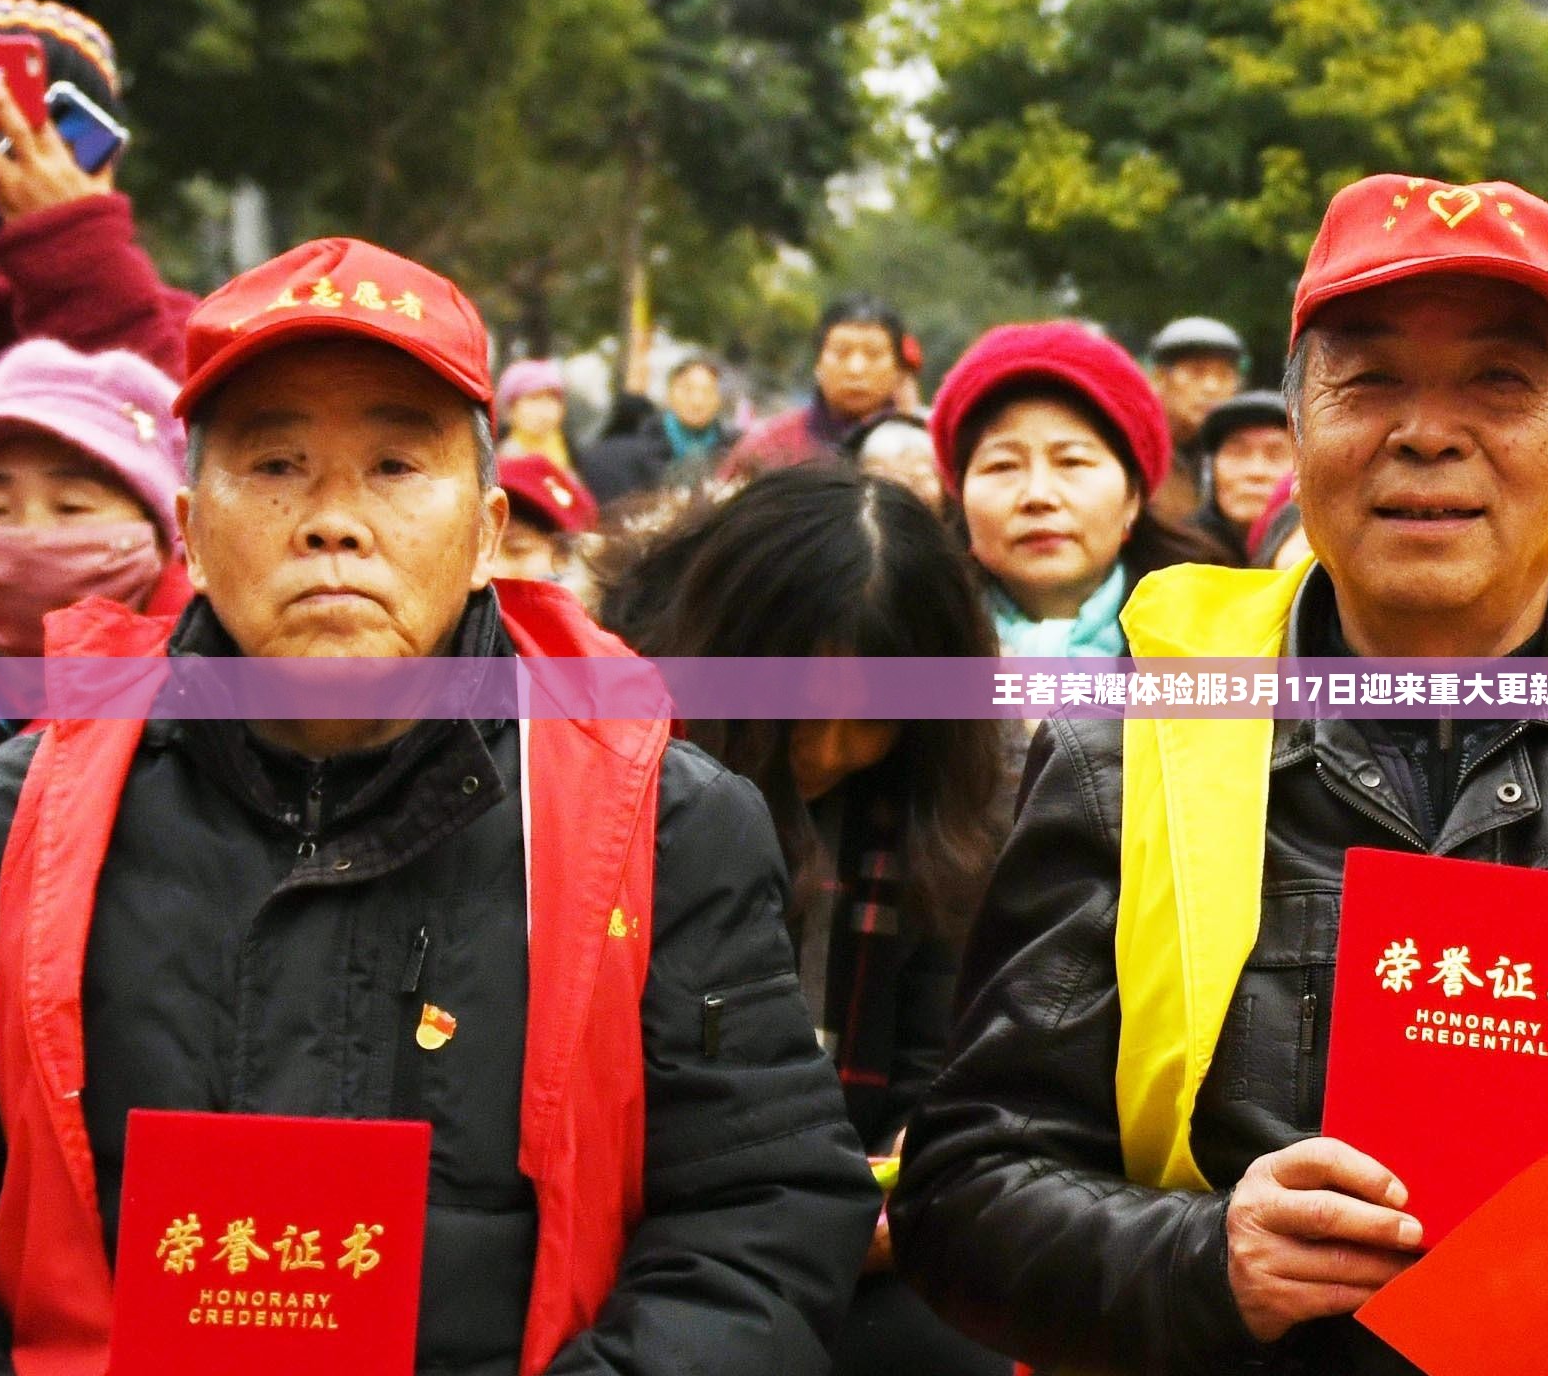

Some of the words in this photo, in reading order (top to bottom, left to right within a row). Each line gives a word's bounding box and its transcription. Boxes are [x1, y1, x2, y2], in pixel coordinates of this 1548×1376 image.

[228, 276, 423, 331] 志愿者
[1416, 1008, 1542, 1037] HONORARY
[1405, 1025, 1548, 1057] CREDENTIAL
[155, 1213, 384, 1280] 荣誉证书
[200, 1289, 332, 1309] HONORARY
[188, 1308, 339, 1329] CREDENTIAL
